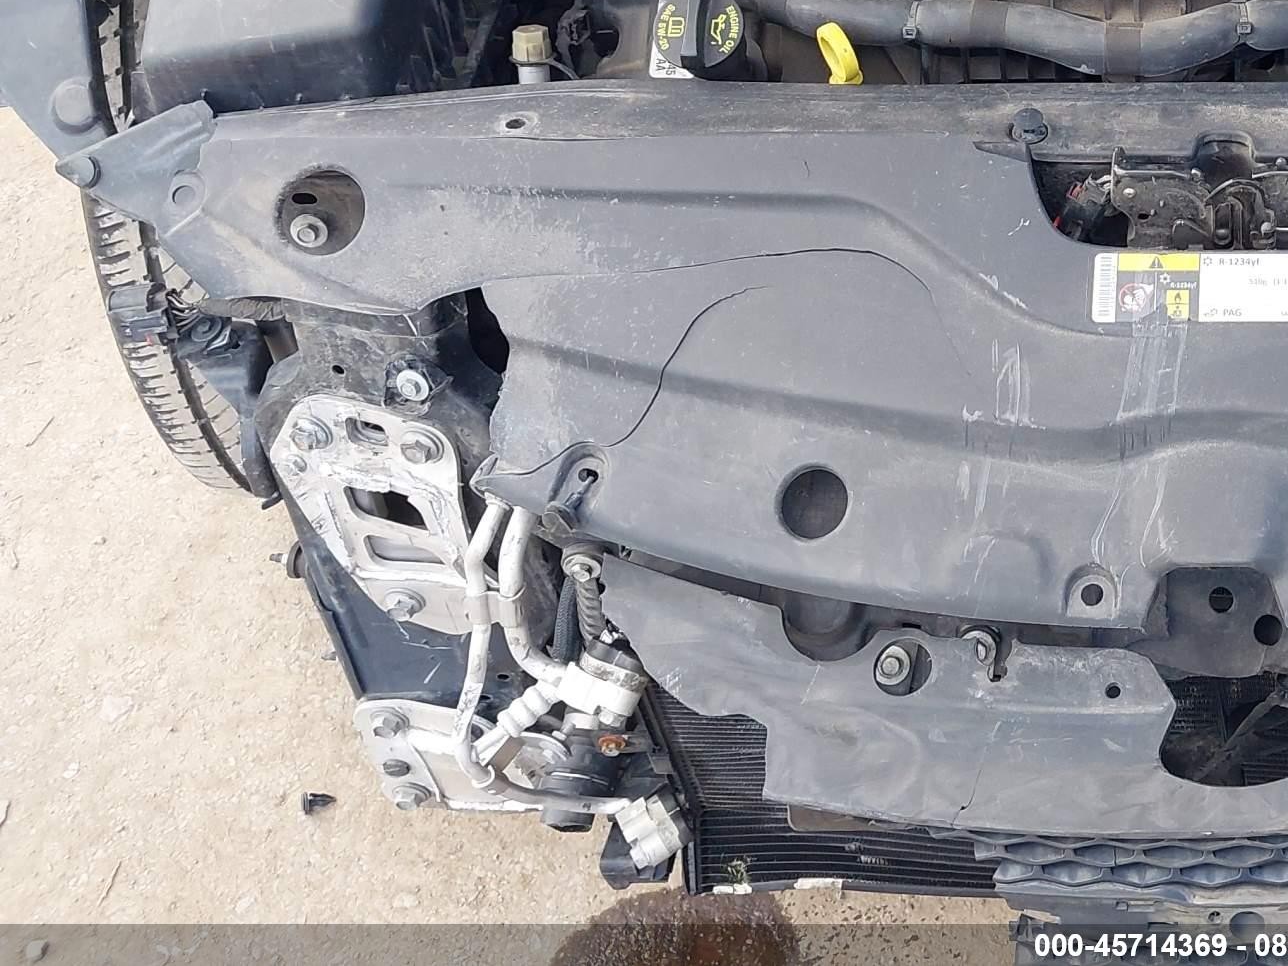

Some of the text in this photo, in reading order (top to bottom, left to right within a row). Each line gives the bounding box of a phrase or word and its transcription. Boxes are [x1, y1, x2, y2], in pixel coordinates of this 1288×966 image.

[656, 4, 676, 51] SAE 5W-20
[718, 5, 740, 54] ENGINE OIL
[655, 58, 667, 71] AA
[1219, 257, 1260, 267] R-1234yf
[1223, 308, 1243, 317] PAG
